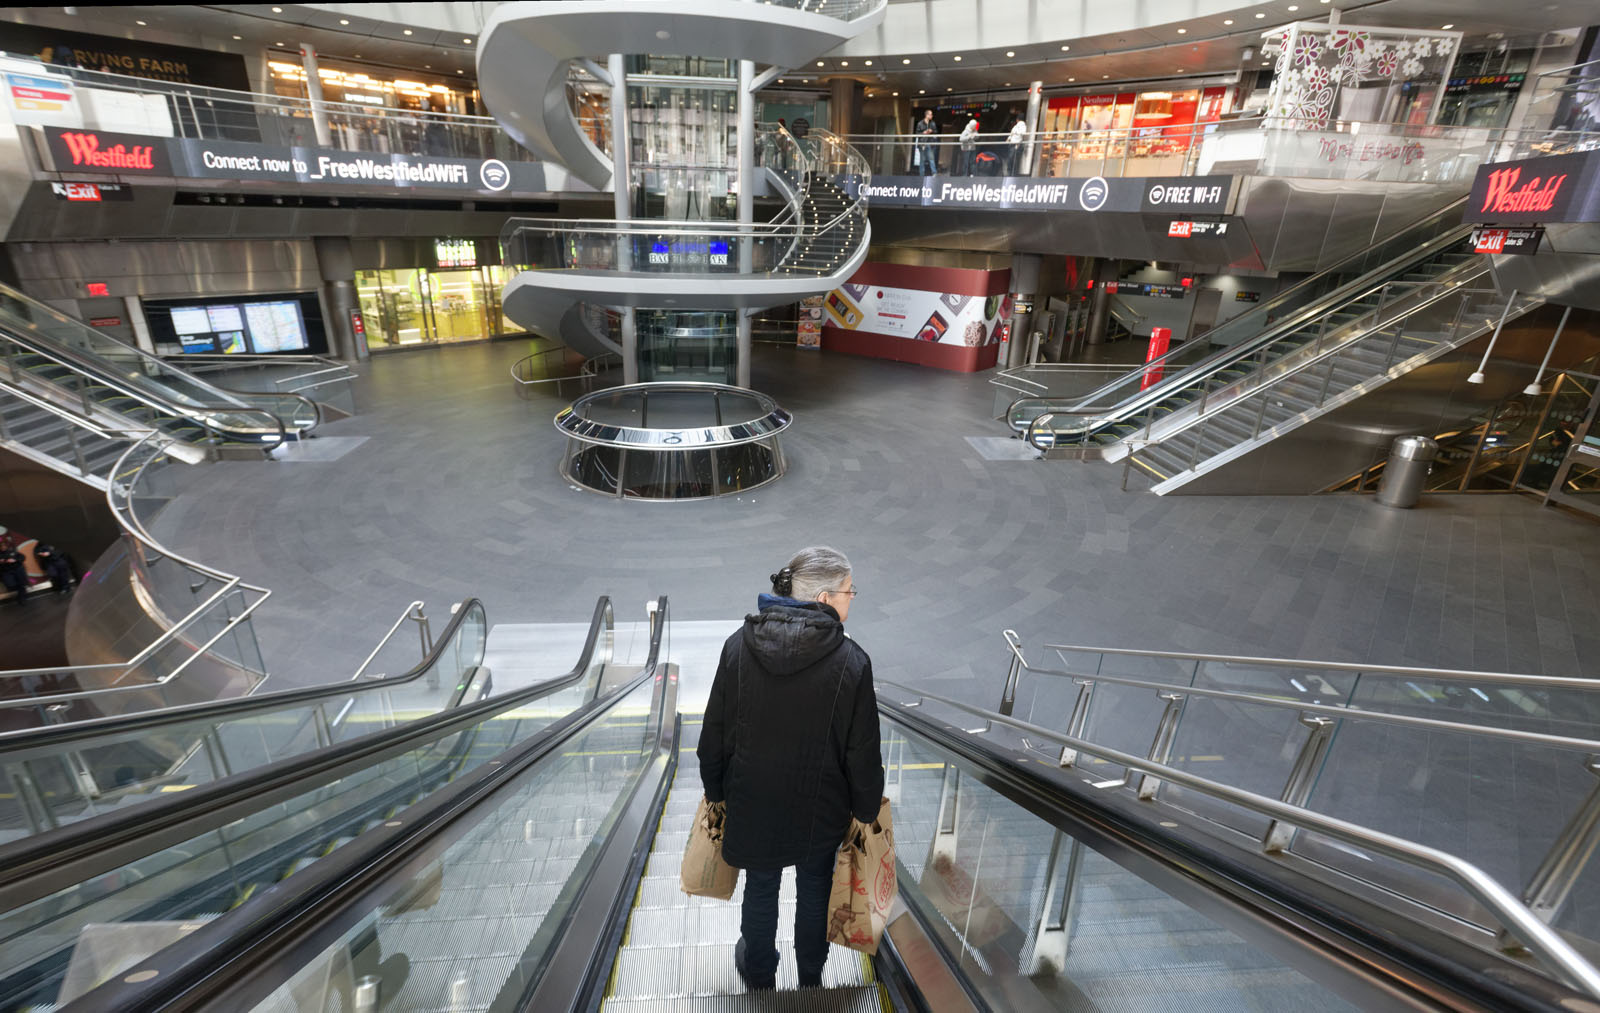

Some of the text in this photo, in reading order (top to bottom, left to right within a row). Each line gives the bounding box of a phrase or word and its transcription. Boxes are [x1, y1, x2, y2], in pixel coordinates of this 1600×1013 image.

[72, 49, 134, 69] RVING
[139, 58, 189, 75] FARM
[60, 131, 155, 169] Westfield
[203, 150, 468, 184] Connect now to _FreeWestfieldWiFi
[65, 183, 98, 199] Exit
[899, 187, 920, 198] now
[922, 186, 932, 198] to
[932, 183, 1068, 204] _FreeWestfieldWiFi
[1165, 186, 1222, 204] FREE WI-FI
[1480, 166, 1568, 213] Westfield
[1168, 221, 1190, 235] Exit
[1475, 230, 1505, 250] Exit
